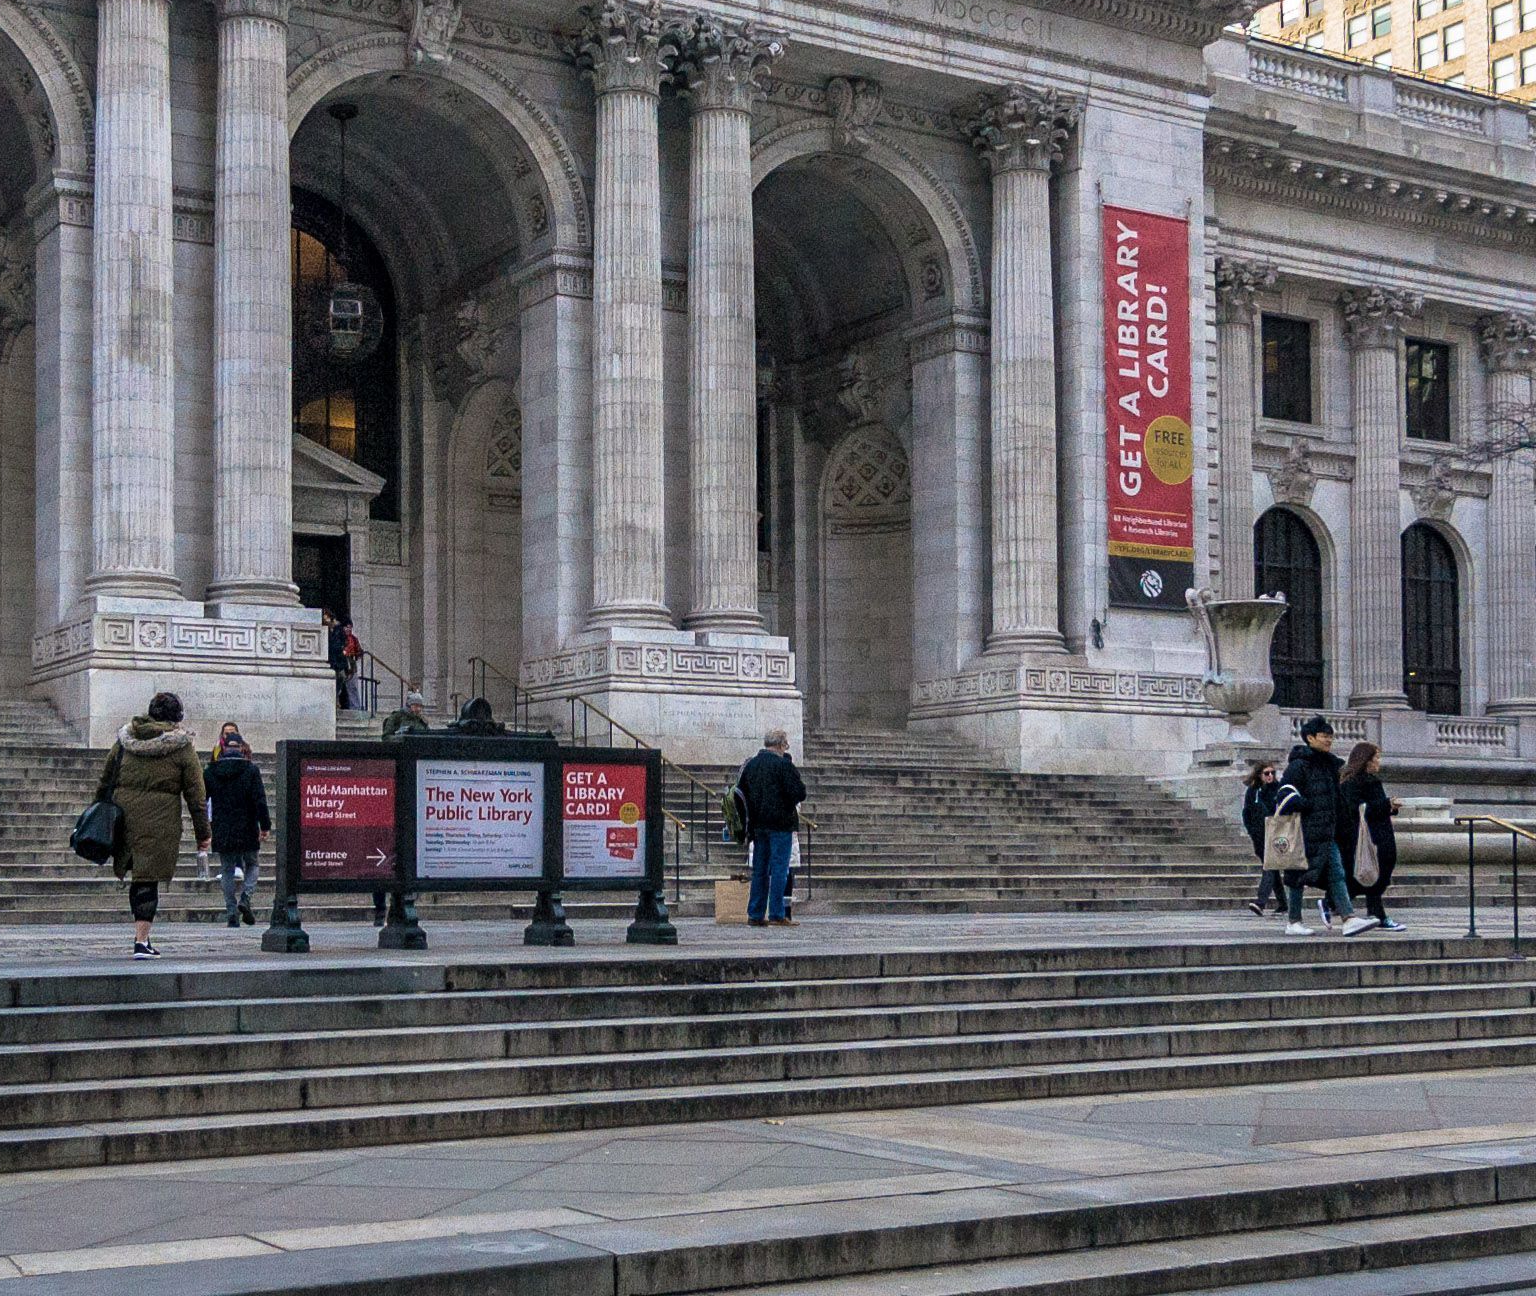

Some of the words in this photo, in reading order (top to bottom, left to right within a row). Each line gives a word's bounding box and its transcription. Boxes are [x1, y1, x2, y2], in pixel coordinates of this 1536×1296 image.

[1116, 220, 1141, 379] LIBRARY
[1146, 283, 1168, 398] CARD!
[1118, 391, 1141, 417] A
[1154, 430, 1185, 445] FREE
[1118, 425, 1142, 497] GET
[1157, 458, 1167, 467] for
[1164, 518, 1187, 529] Libraries
[566, 772, 593, 784] GET
[597, 772, 607, 784] A
[306, 784, 387, 795] Mid-Manhattan
[426, 786, 454, 801] The
[461, 788, 495, 802] New
[500, 788, 532, 803] York
[566, 788, 625, 800] LIBRARY
[306, 797, 344, 810] Library
[566, 803, 610, 815] CARD!
[426, 805, 473, 821] Public
[479, 805, 532, 825] Library
[305, 850, 347, 859] Entrance
